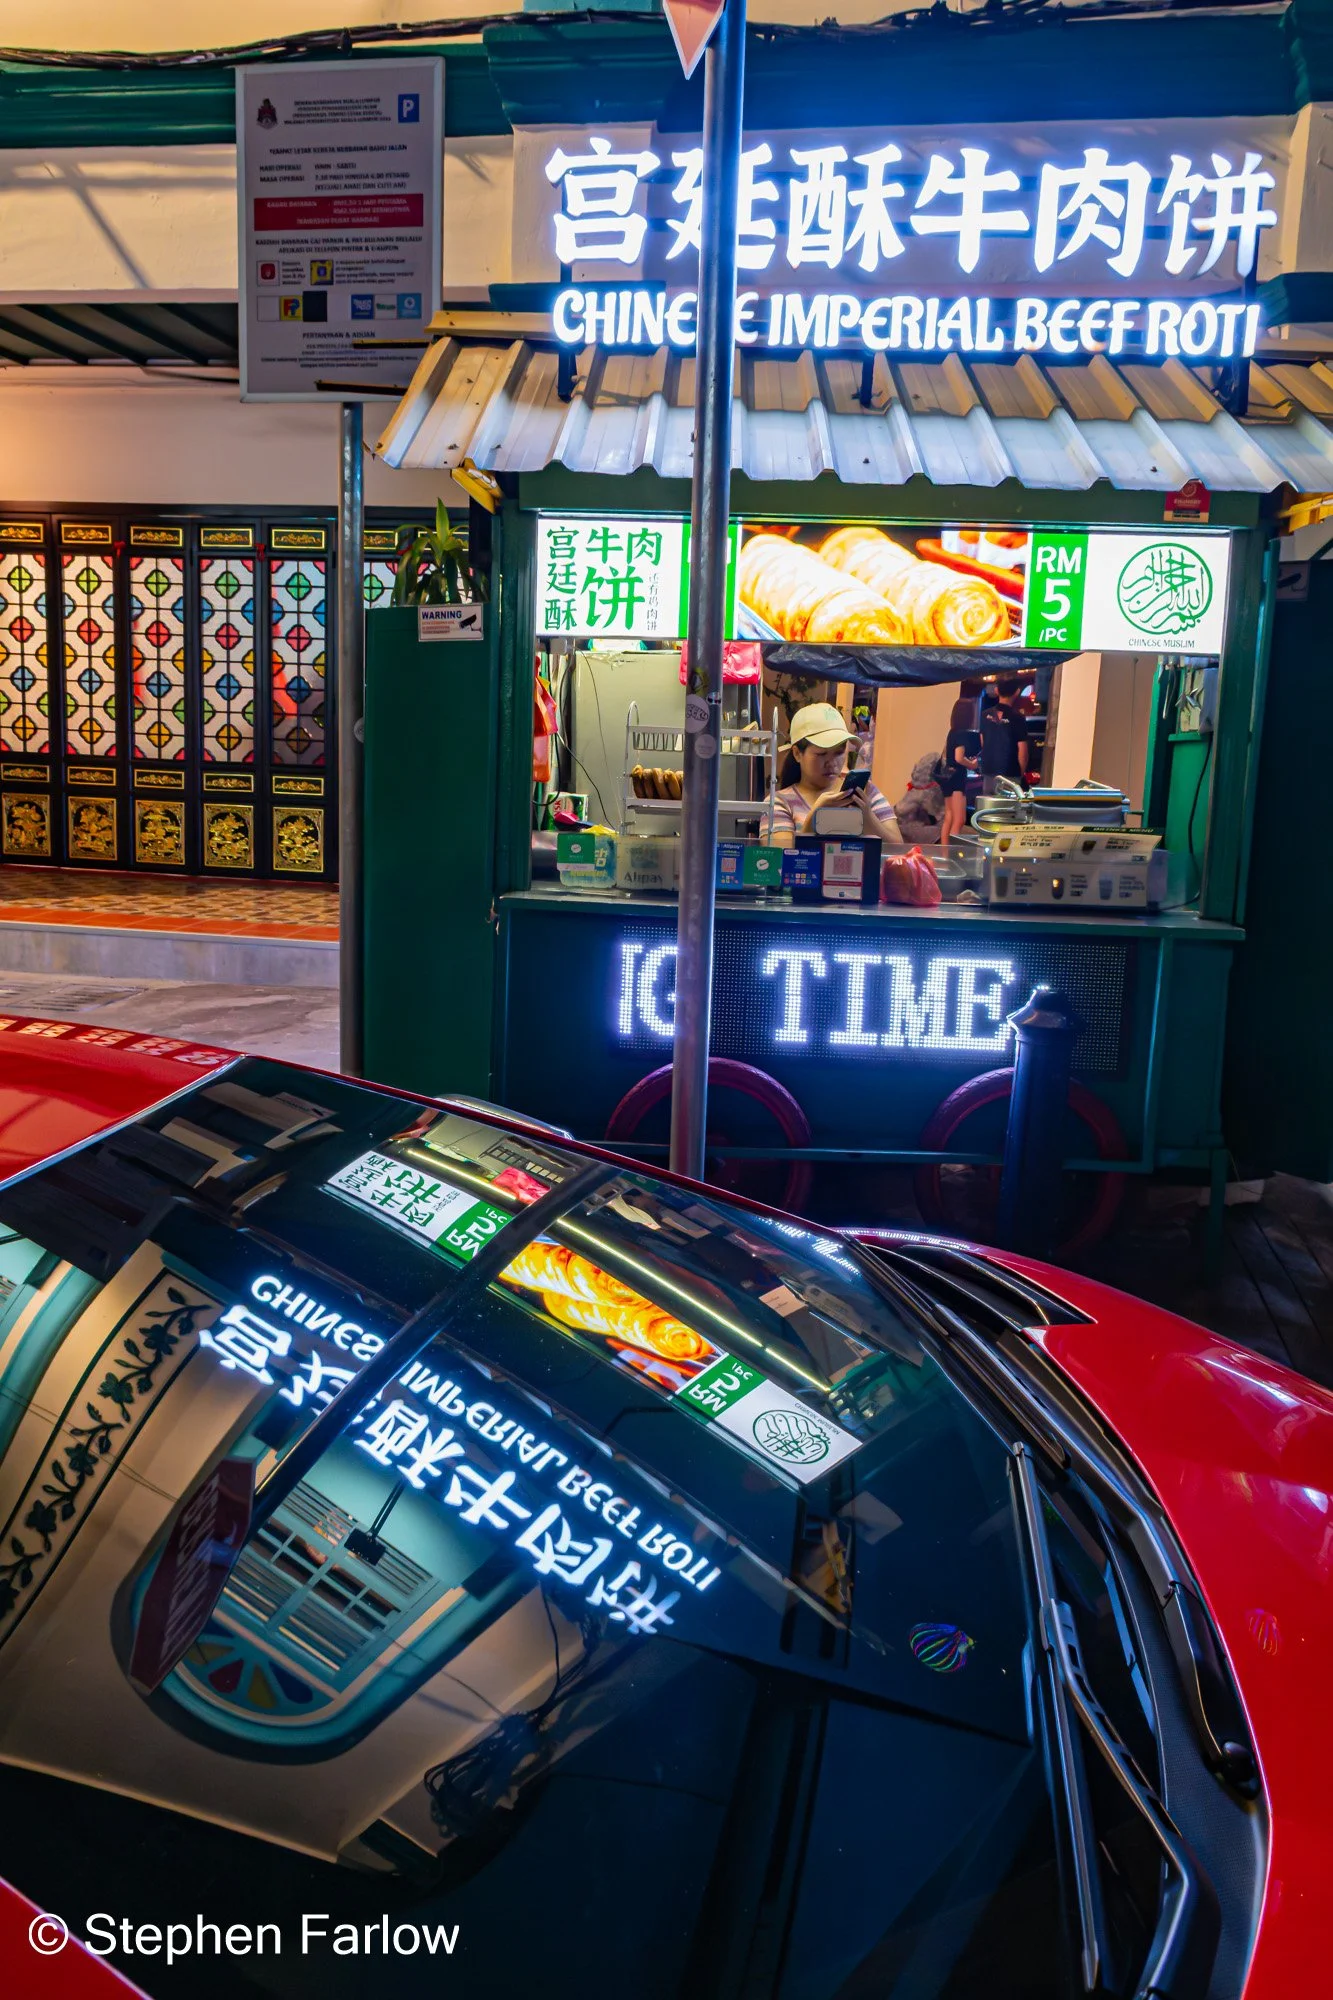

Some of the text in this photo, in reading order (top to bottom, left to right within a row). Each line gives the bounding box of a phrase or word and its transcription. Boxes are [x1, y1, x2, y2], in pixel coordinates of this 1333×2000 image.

[402, 99, 414, 118] P
[553, 291, 1263, 358] CHINEE IMPERIAL BEEF ROTI
[585, 526, 663, 567] 牛肉
[1035, 545, 1082, 574] RM
[544, 526, 580, 630] 宫廷酥
[580, 565, 646, 631] 饼
[422, 610, 462, 620] WARNING
[1040, 577, 1071, 622] 5
[1038, 627, 1068, 643] /PC
[1128, 637, 1195, 649] CHINESE MUSLIM
[761, 949, 1015, 1051] TIME
